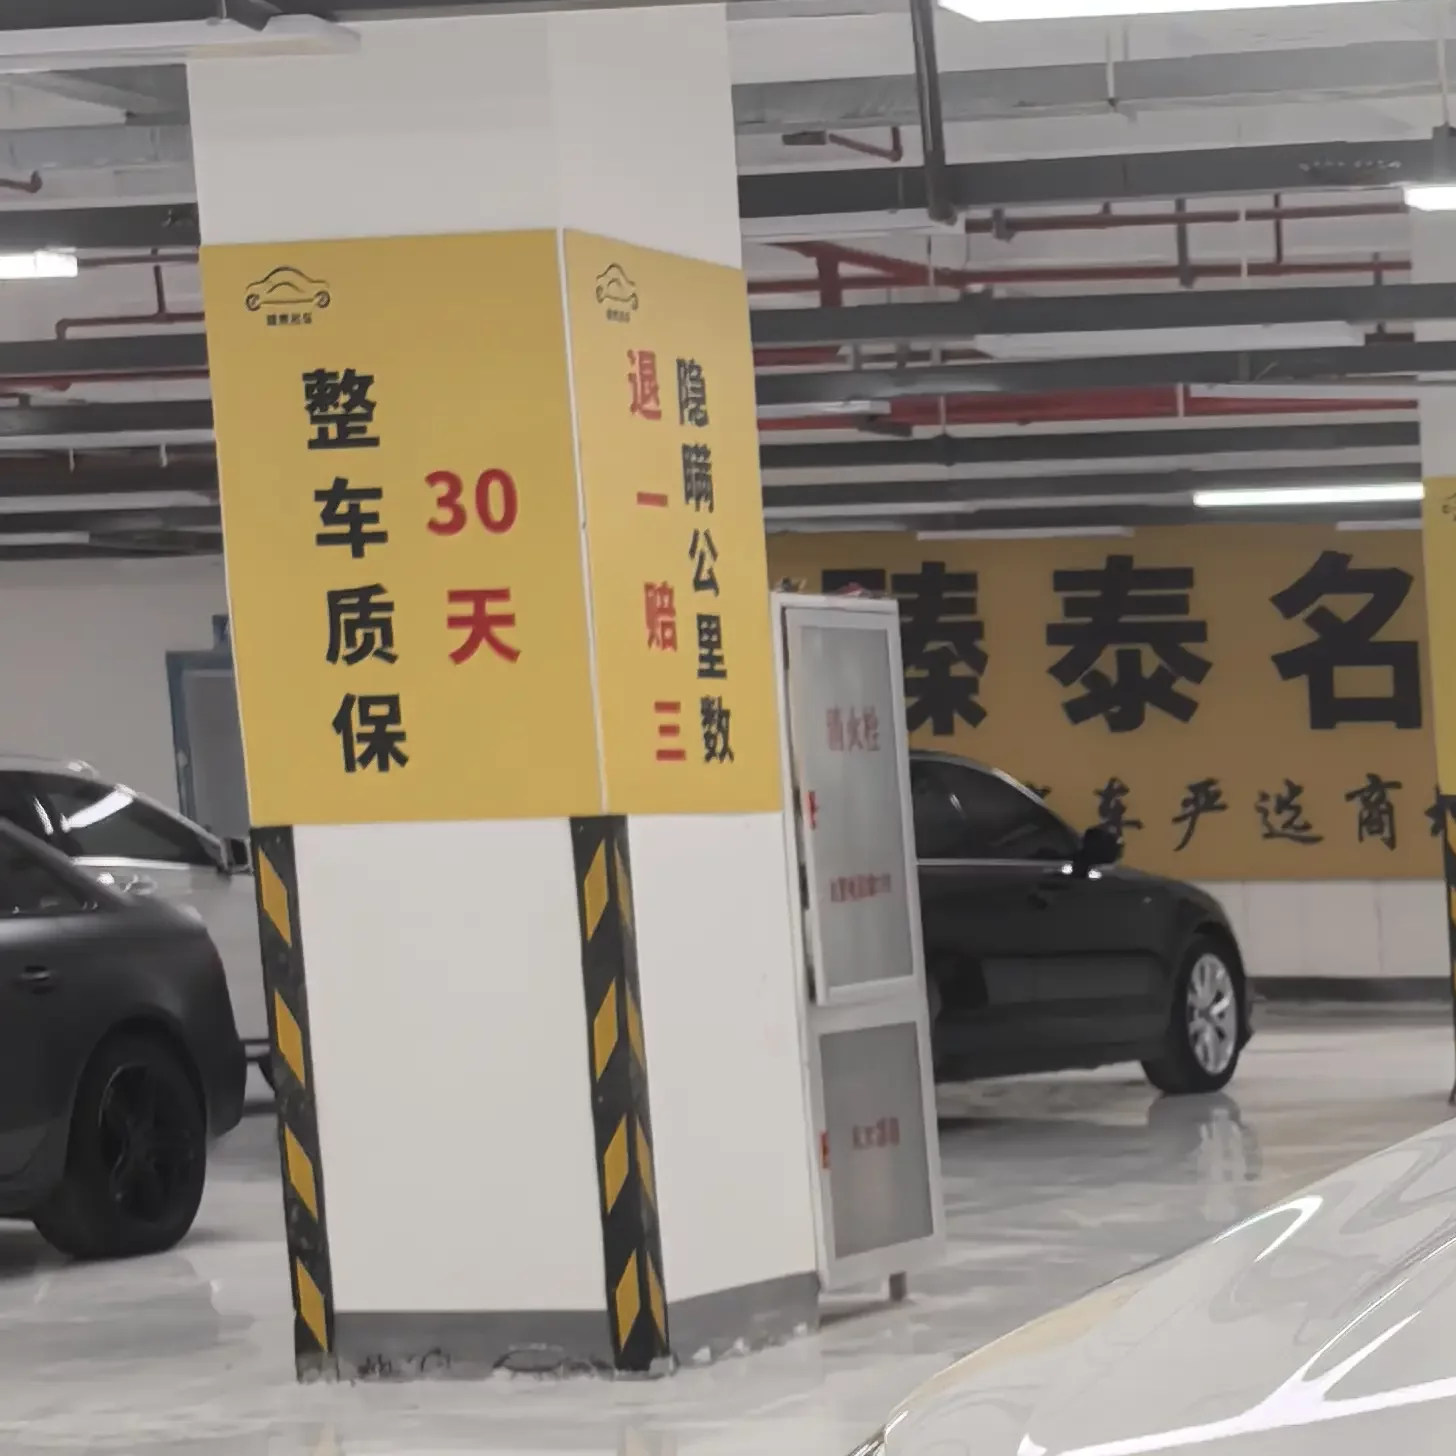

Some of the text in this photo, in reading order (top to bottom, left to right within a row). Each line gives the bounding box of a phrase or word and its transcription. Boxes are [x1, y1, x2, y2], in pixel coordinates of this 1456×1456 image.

[302, 368, 409, 772] 整车质保
[627, 350, 686, 761] 退一赔三
[676, 358, 733, 764] 隐瞒公里数
